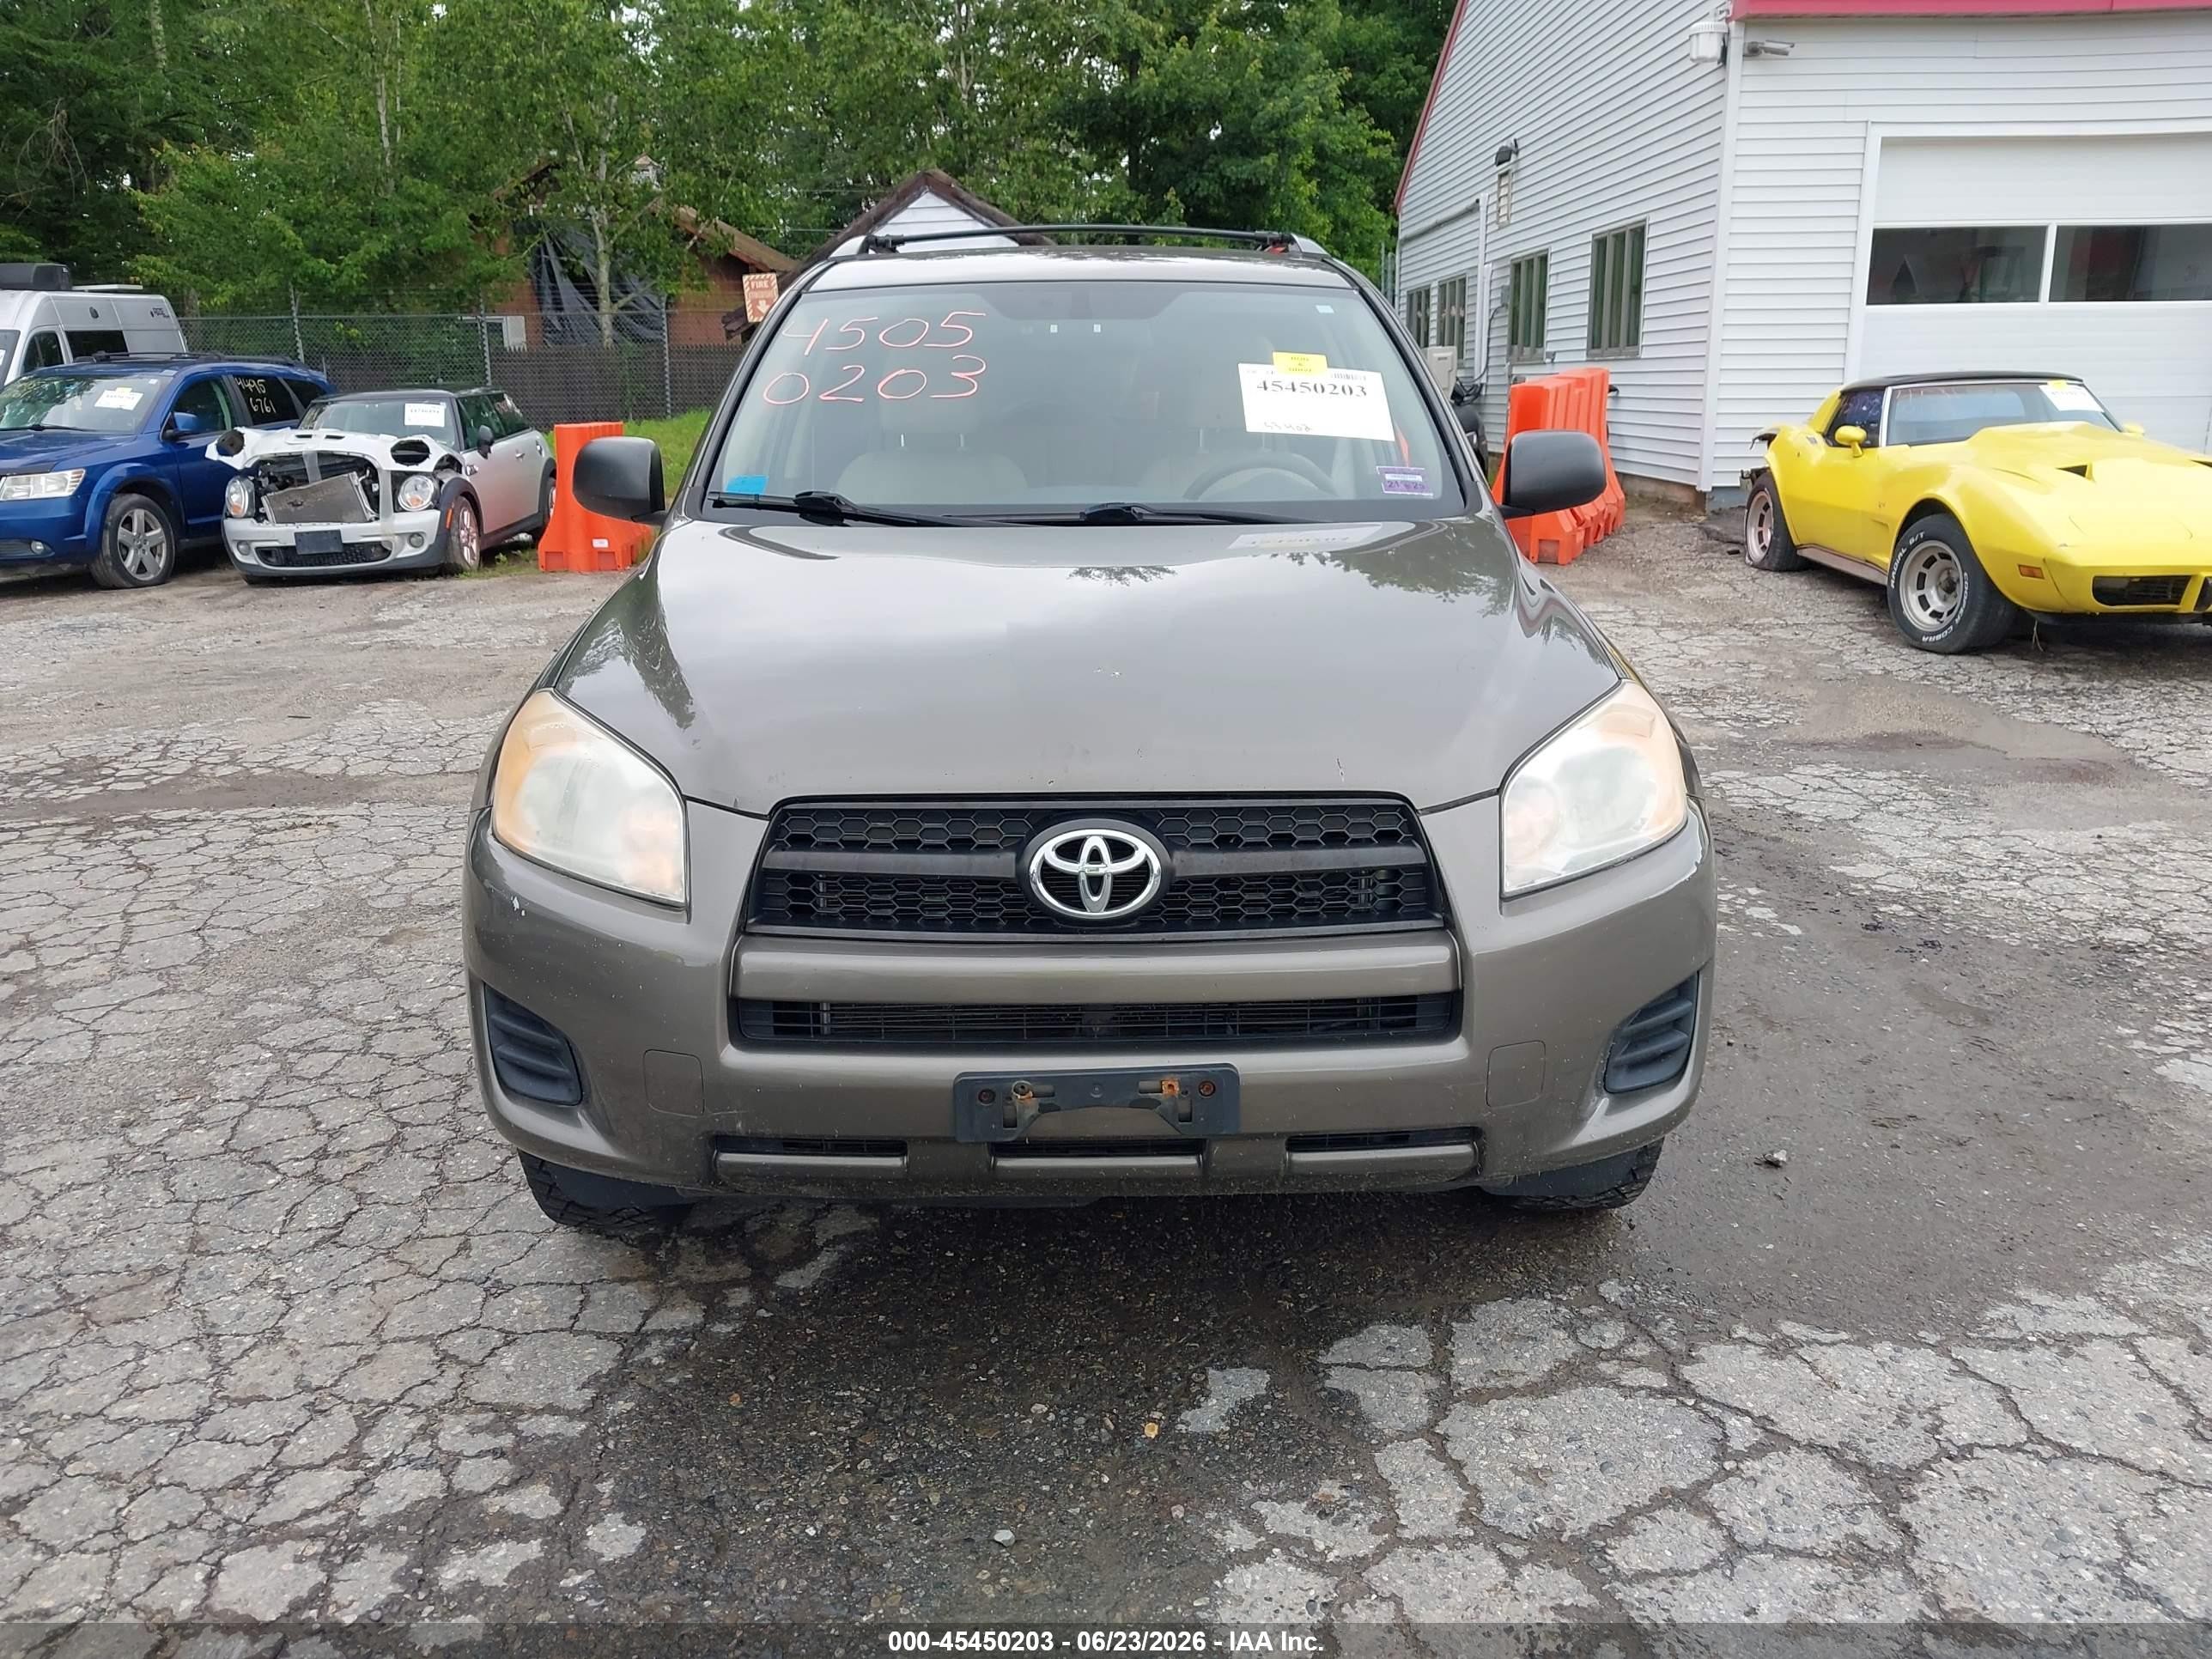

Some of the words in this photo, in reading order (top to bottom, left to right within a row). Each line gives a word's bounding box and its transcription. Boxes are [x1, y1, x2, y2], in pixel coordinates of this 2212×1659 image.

[750, 280, 769, 289] FIRE
[781, 311, 987, 356] 4505
[234, 377, 266, 394] 4495
[763, 355, 987, 405] 0203
[1256, 380, 1368, 398] 45450203
[249, 397, 276, 414] 6761
[1890, 546, 1907, 589] RADIAL
[1954, 571, 1969, 624] COOPER
[1922, 625, 1954, 642] COBRA
